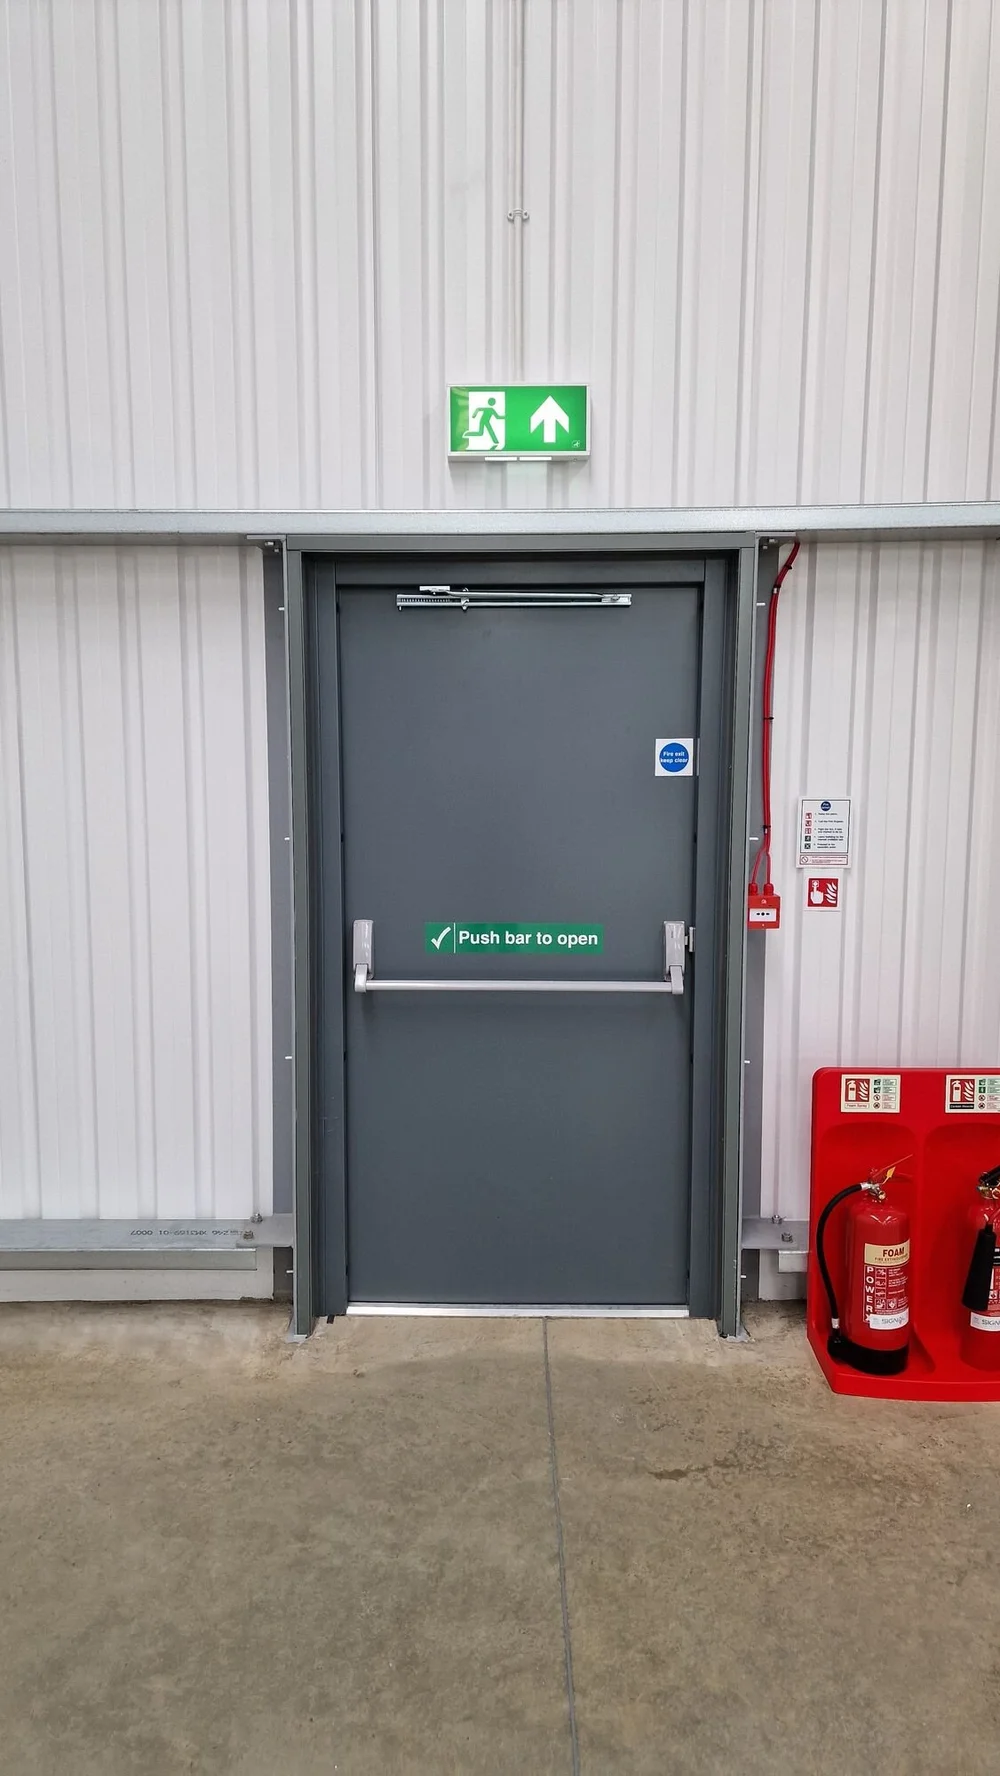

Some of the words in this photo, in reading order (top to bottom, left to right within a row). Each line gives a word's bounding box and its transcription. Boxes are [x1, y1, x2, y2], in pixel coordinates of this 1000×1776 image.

[459, 930, 500, 945] Push
[505, 930, 532, 945] bar
[536, 932, 553, 945] to
[557, 933, 598, 949] open
[882, 1247, 904, 1257] FOAM
